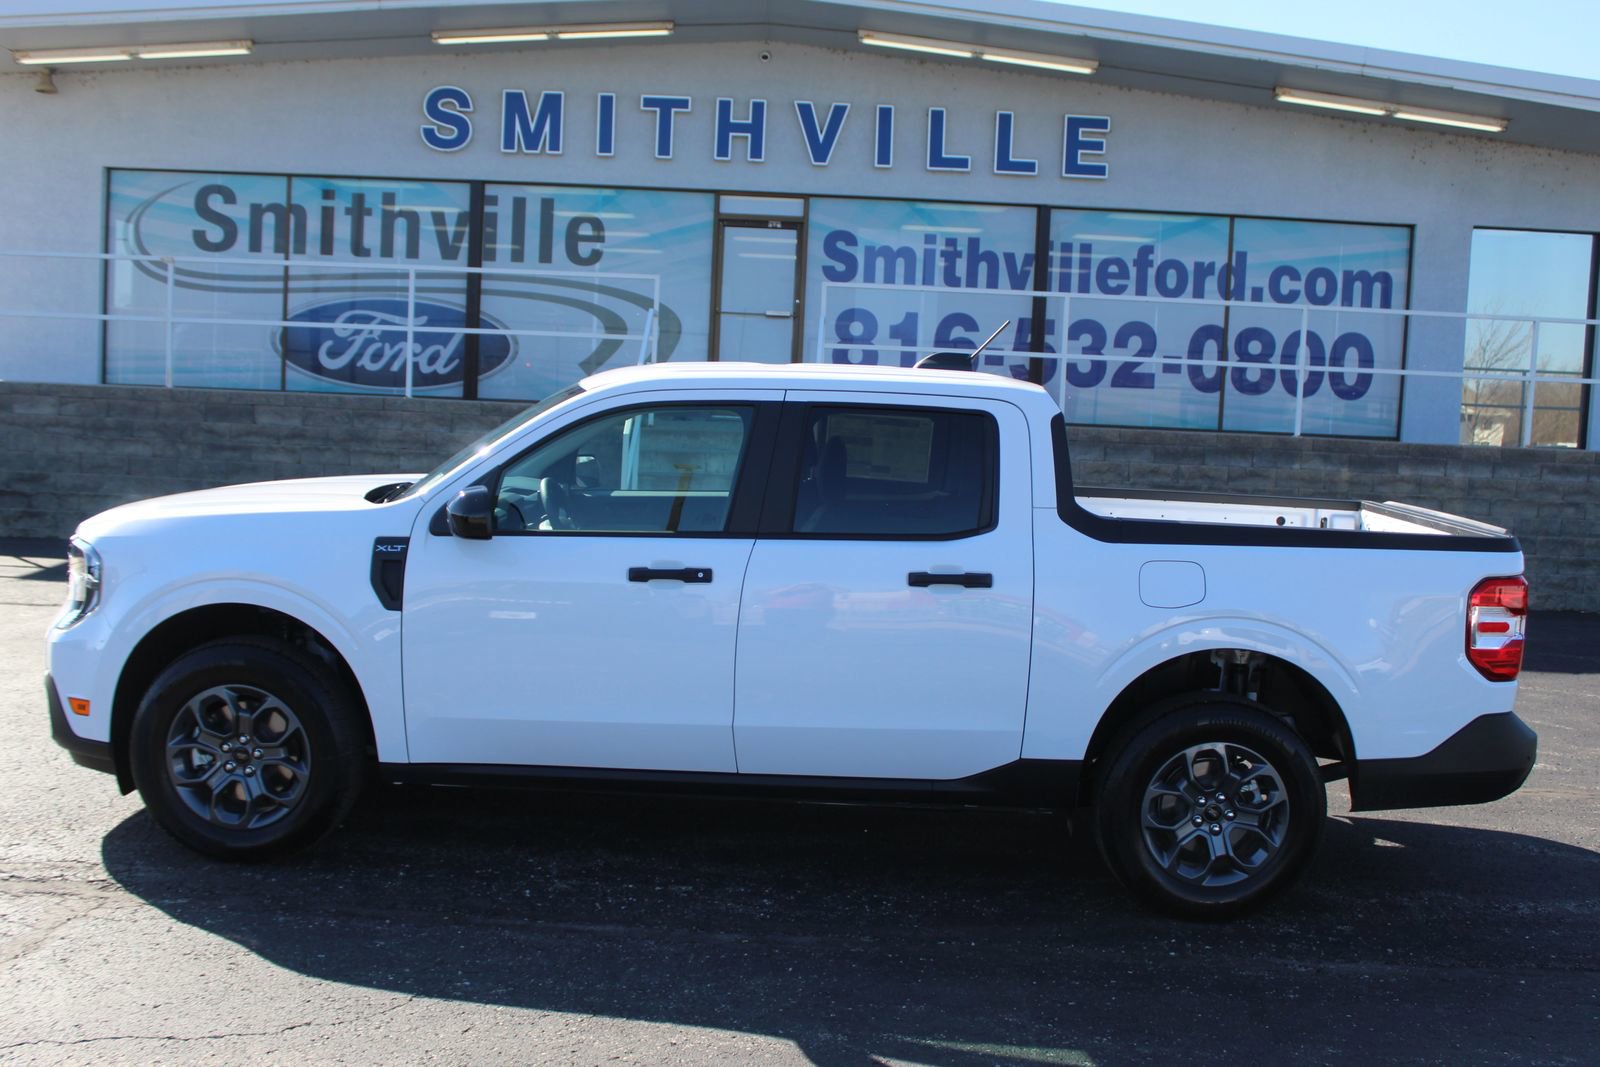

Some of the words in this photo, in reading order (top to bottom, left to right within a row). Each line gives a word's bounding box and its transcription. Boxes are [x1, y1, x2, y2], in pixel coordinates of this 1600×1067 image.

[420, 85, 1111, 178] SMITHVILLE
[192, 184, 606, 267] Smithville
[318, 309, 466, 375] Ford
[832, 307, 1375, 401] 816-532-0800
[375, 544, 407, 552] XLT
